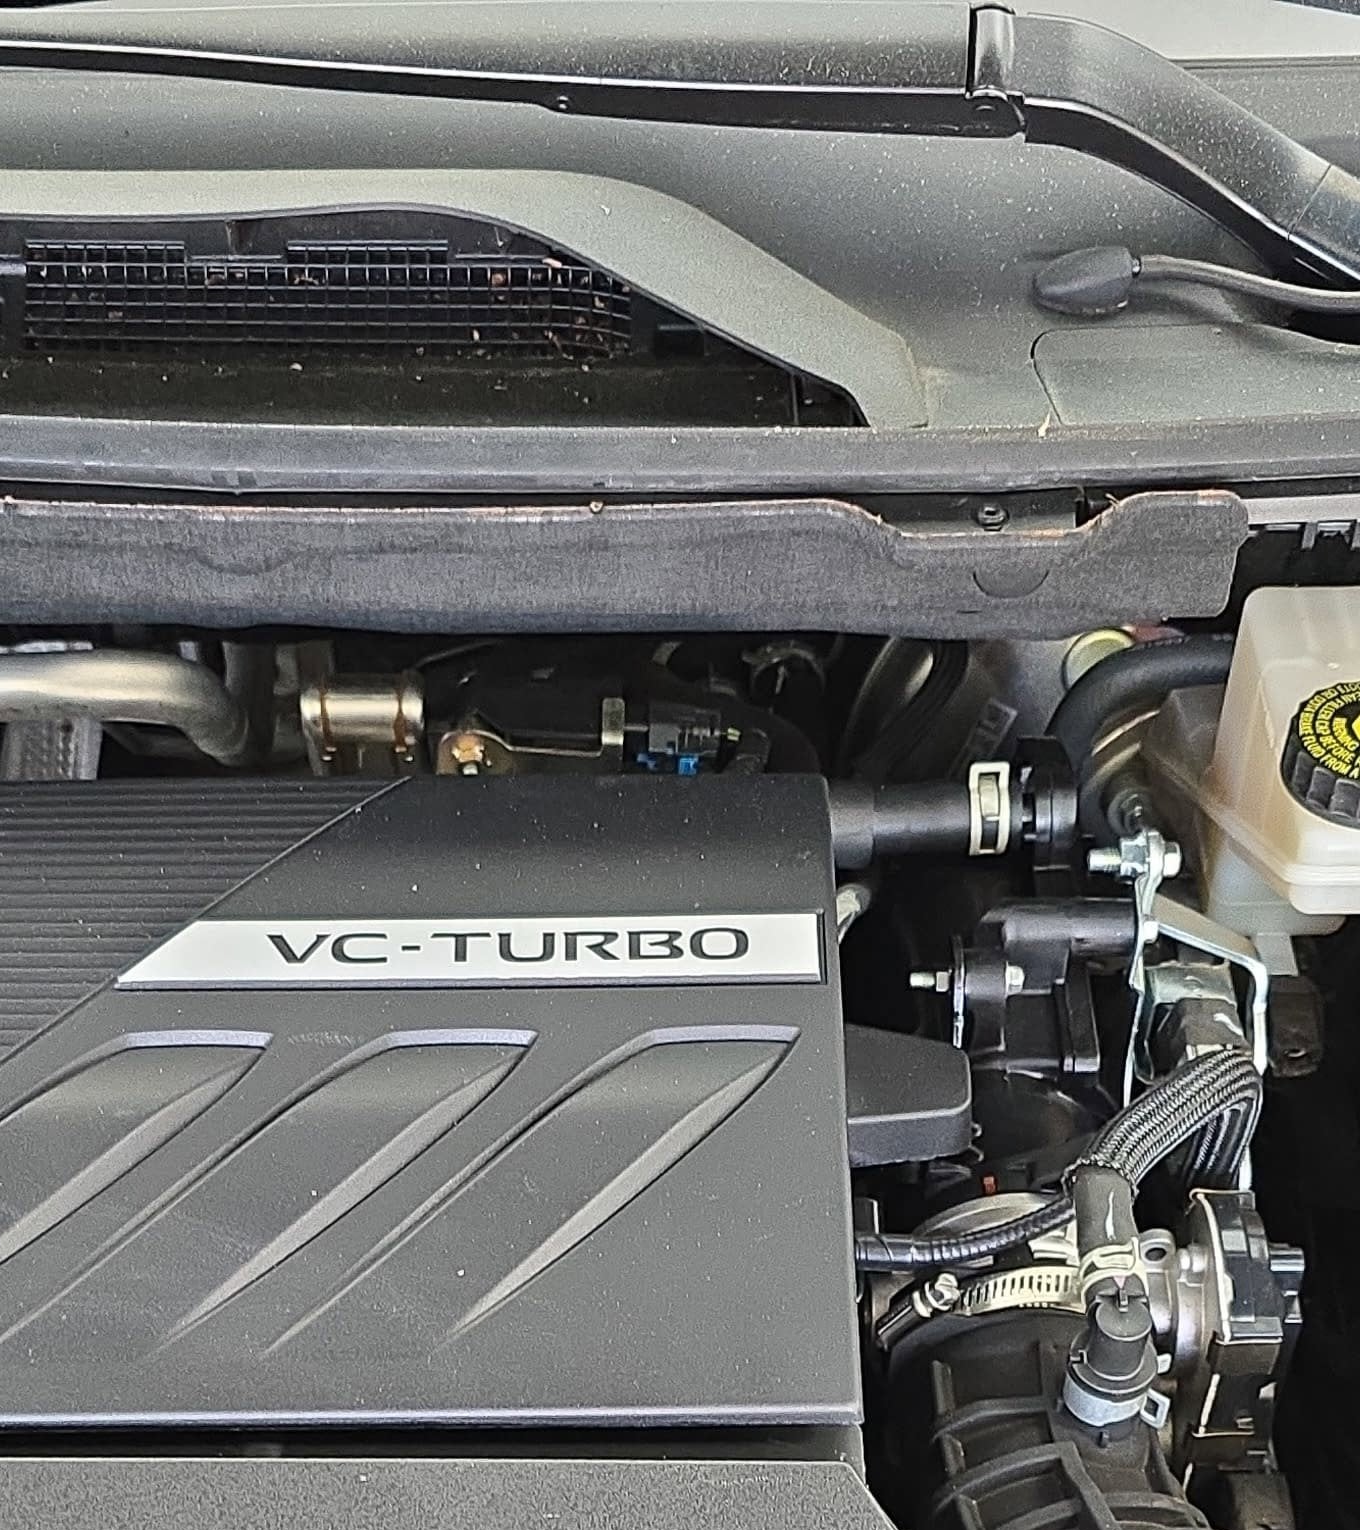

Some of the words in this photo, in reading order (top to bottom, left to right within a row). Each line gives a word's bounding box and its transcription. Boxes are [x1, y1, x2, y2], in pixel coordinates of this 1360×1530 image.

[1301, 735, 1326, 759] FLUID
[1320, 753, 1352, 776] FROM
[1349, 767, 1359, 779] A
[1319, 733, 1356, 763] BEFORE
[266, 927, 750, 964] VC-TURBO
